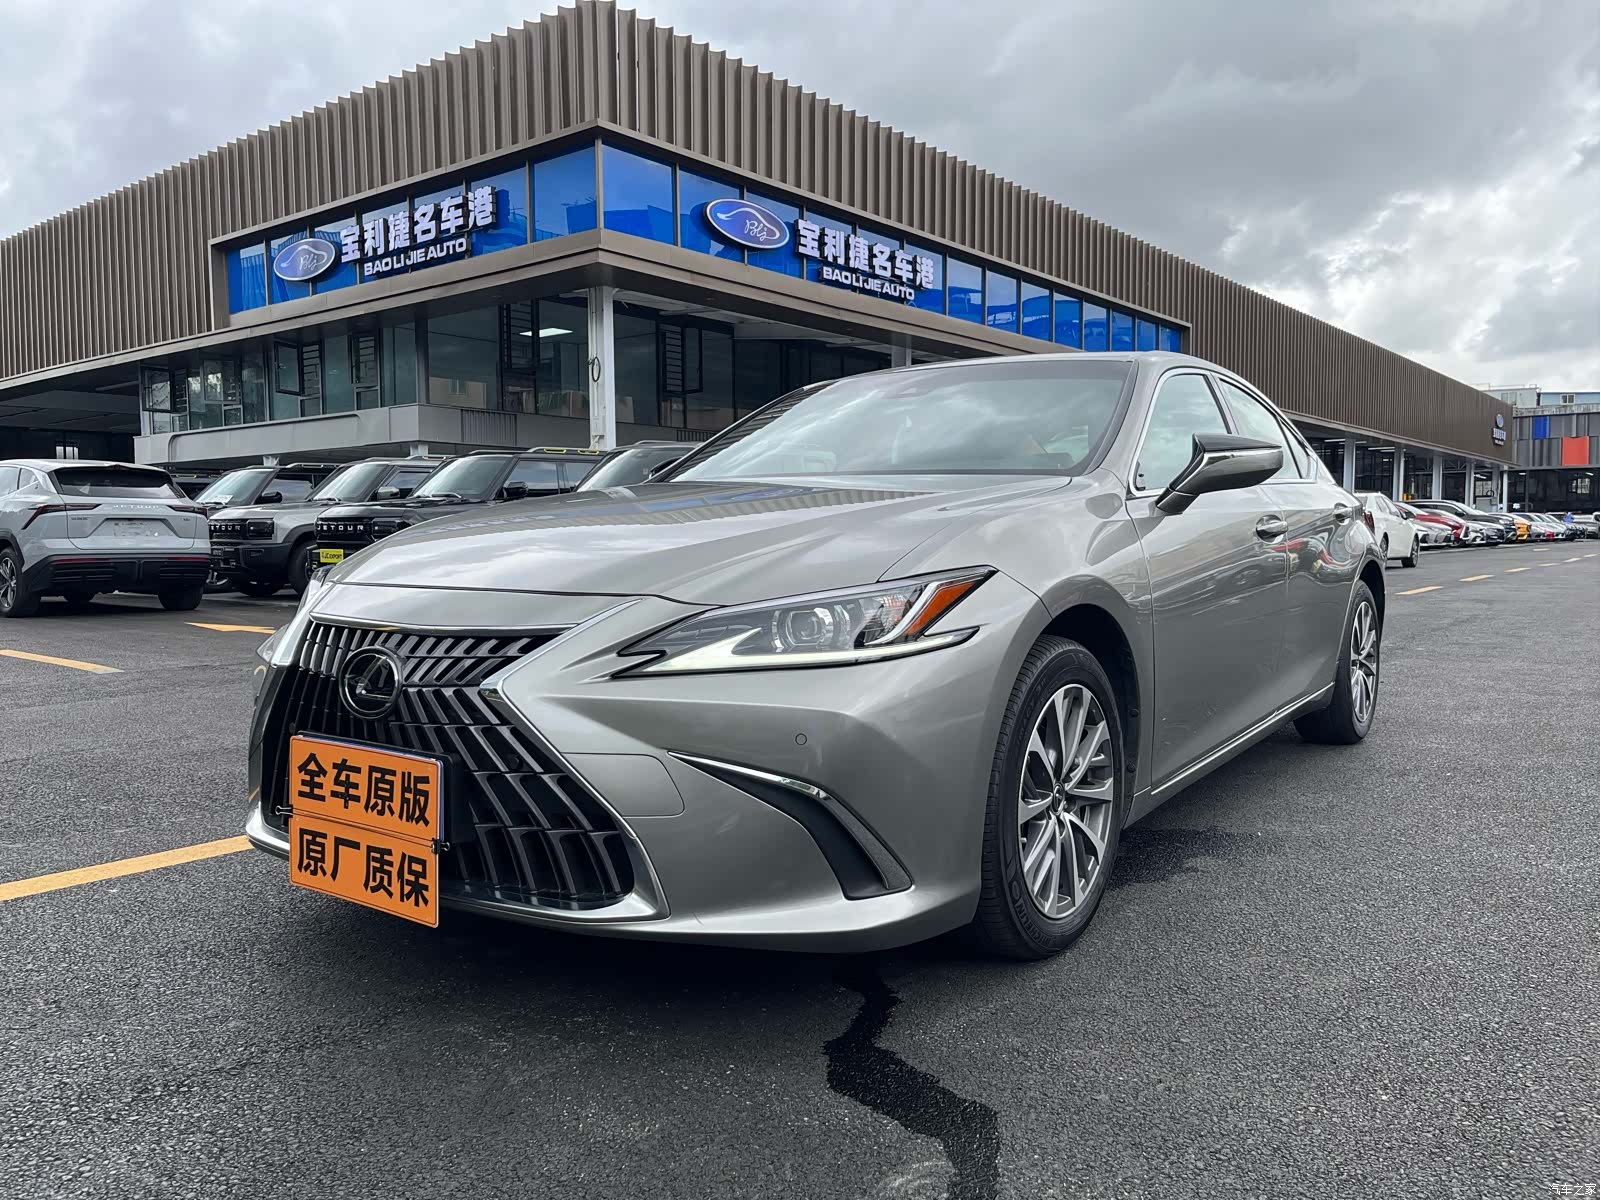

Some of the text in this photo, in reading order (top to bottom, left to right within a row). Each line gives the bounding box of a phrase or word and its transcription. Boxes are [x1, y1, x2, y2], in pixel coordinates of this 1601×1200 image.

[340, 185, 496, 264] 宝利捷名车港
[426, 237, 467, 261] AUTO
[797, 218, 934, 289] 宝利捷名车港
[882, 282, 915, 301] AUTO
[297, 752, 431, 827] 全车原版
[297, 827, 429, 907] 原厂质保
